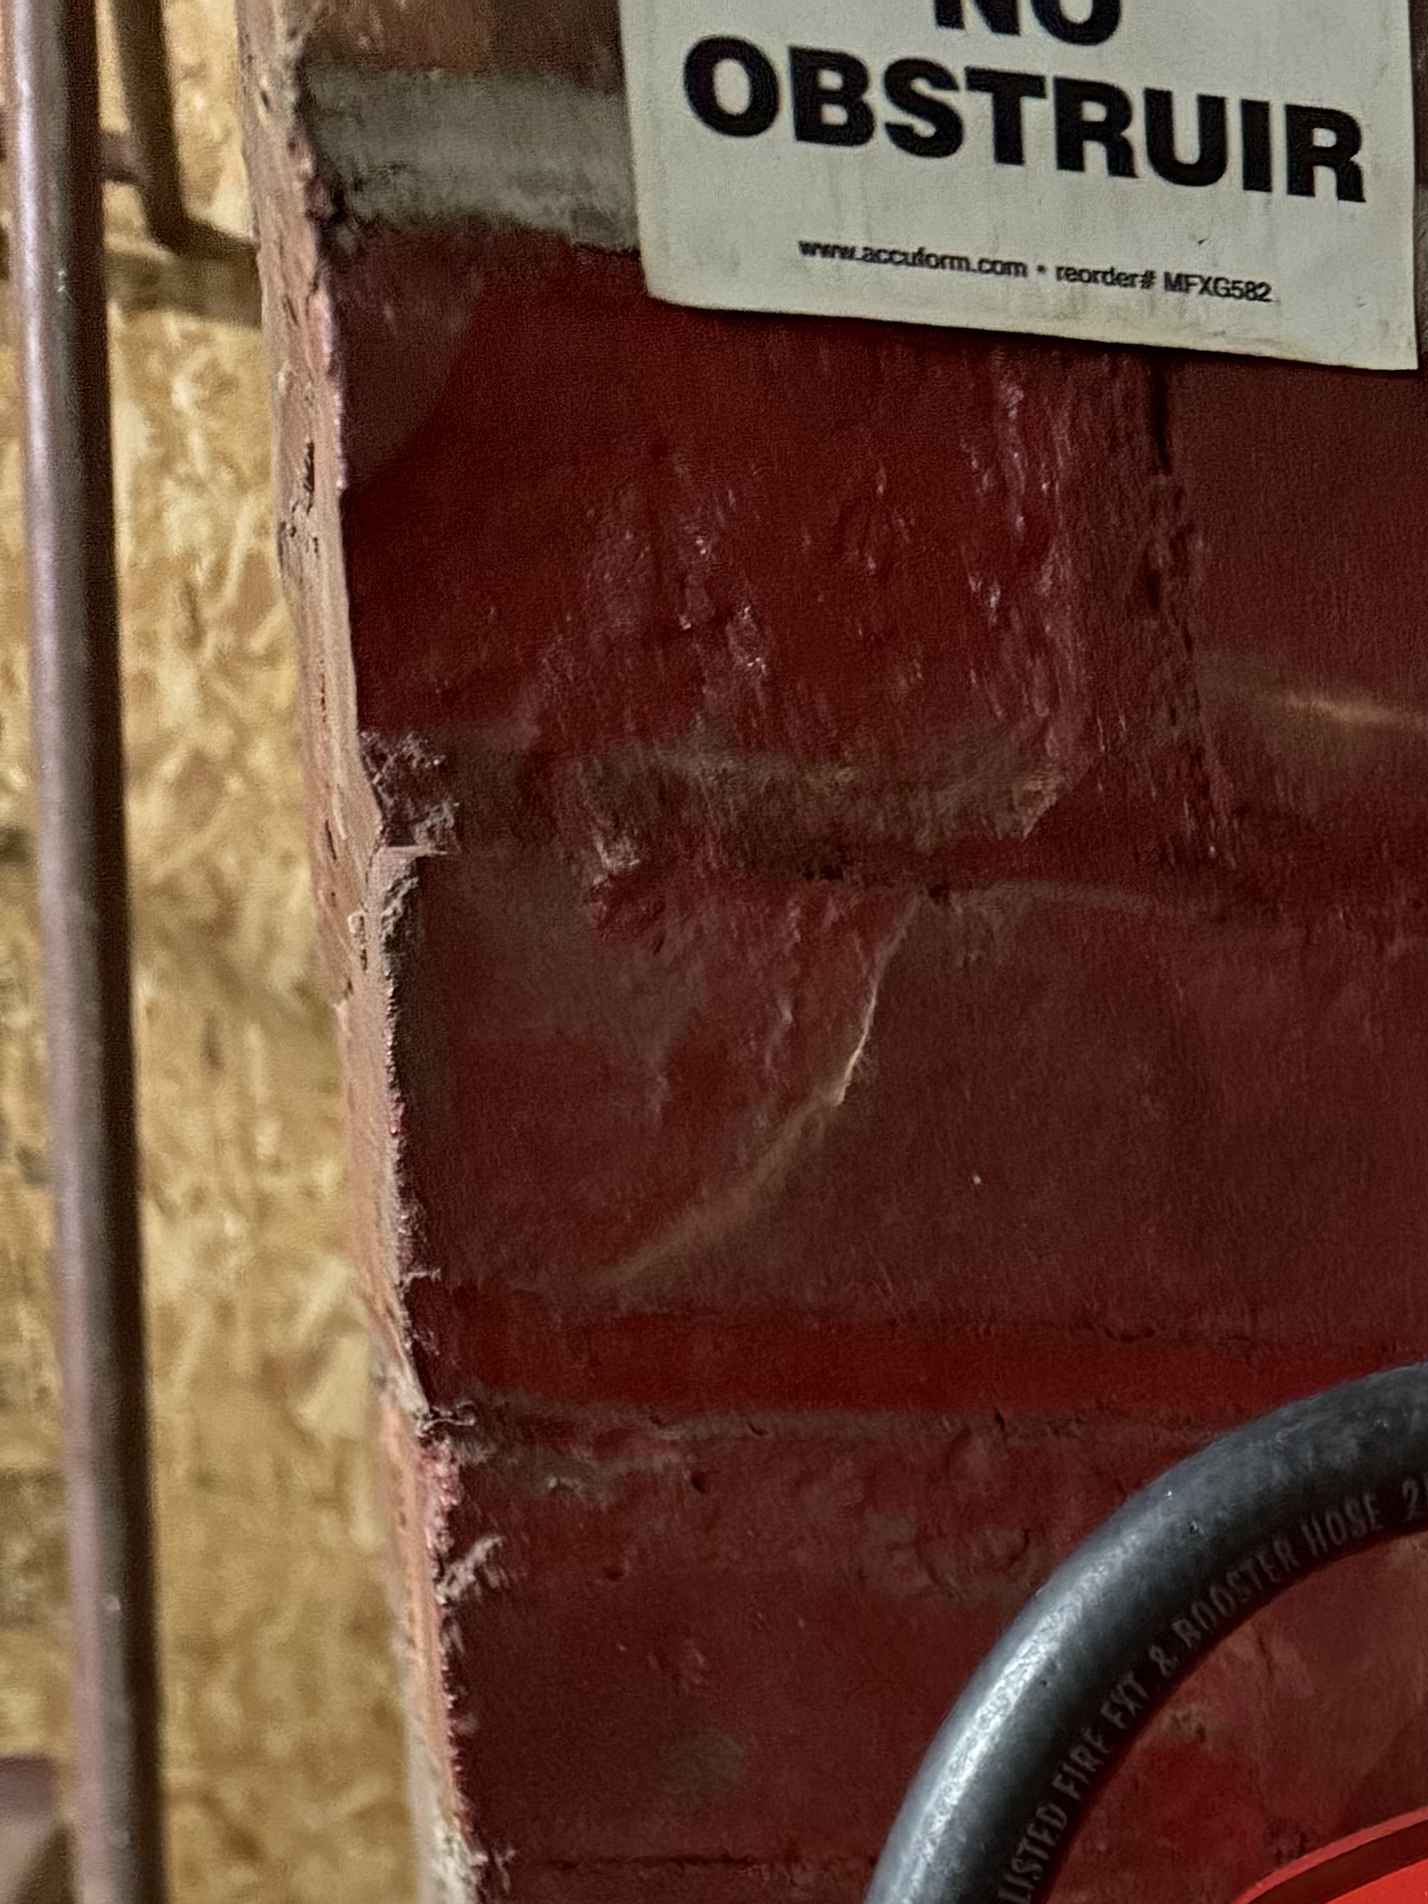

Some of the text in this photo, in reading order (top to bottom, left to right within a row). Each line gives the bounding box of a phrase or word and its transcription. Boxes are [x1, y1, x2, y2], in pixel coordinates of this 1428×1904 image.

[683, 34, 1367, 204] OBSTRUIR
[798, 239, 1273, 304] www.accuform.com reorder# MFXG582
[1300, 1493, 1385, 1559] HOSE
